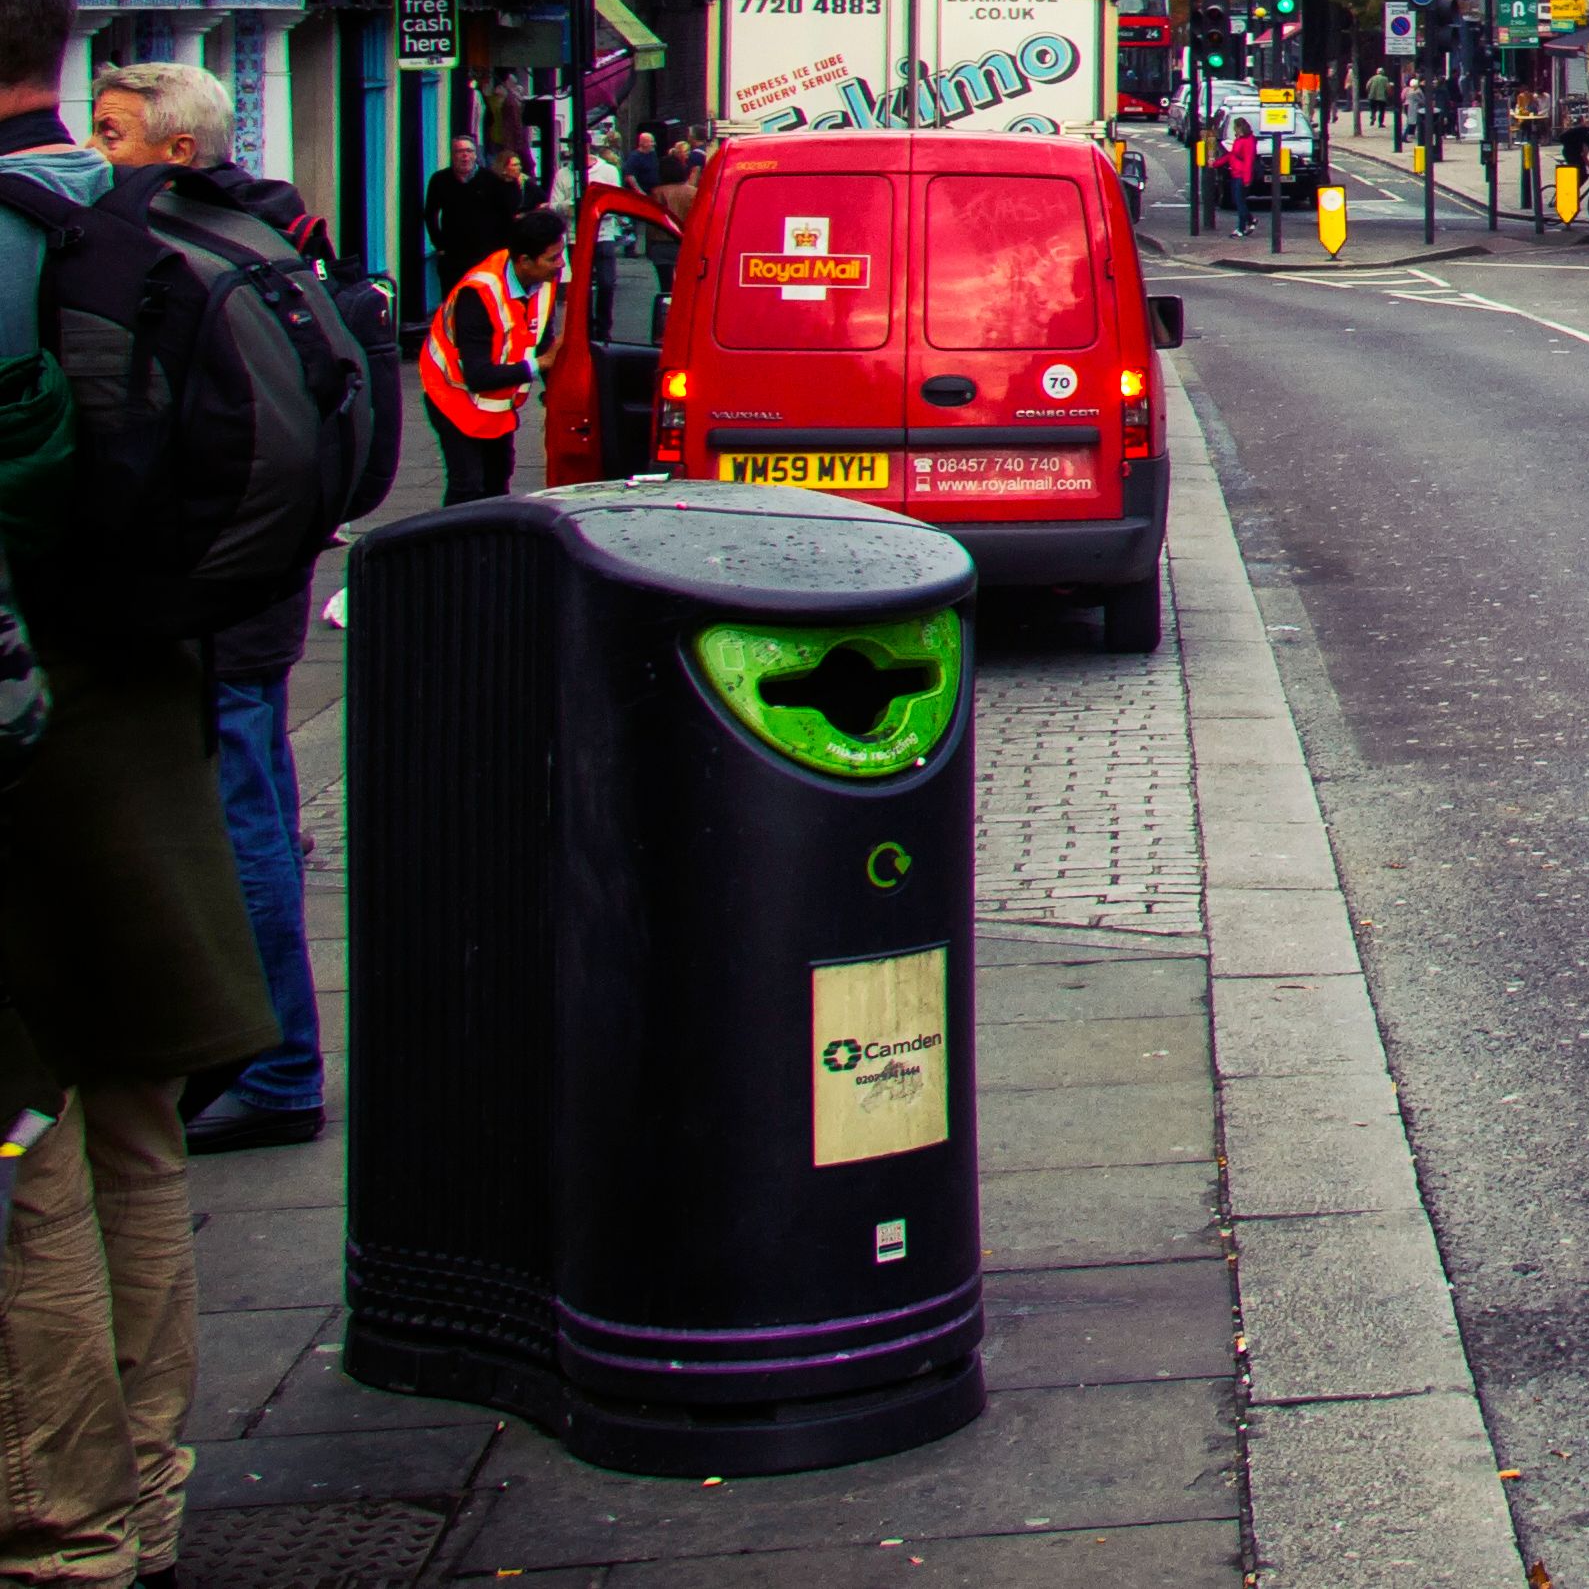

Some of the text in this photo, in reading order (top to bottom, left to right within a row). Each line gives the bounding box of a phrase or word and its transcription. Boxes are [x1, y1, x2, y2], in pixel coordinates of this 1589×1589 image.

[969, 7, 1035, 20] .CO.UK
[402, 14, 452, 32] cash
[1145, 26, 1159, 39] 24
[405, 34, 451, 52] here
[736, 53, 845, 101] EXPRESS ICE CUBE
[741, 66, 850, 114] DELIVERY SERVICE
[748, 258, 860, 283] Royal Mail
[1049, 377, 1071, 389] 70
[712, 411, 784, 420] VAUXHALL
[1015, 409, 1066, 419] COMBO
[731, 453, 876, 483] WM59 MYH
[937, 457, 1060, 473] 08457 740 740
[937, 476, 1092, 493] www.royalmail.com
[827, 742, 867, 761] mixed
[864, 1033, 942, 1060] Camden
